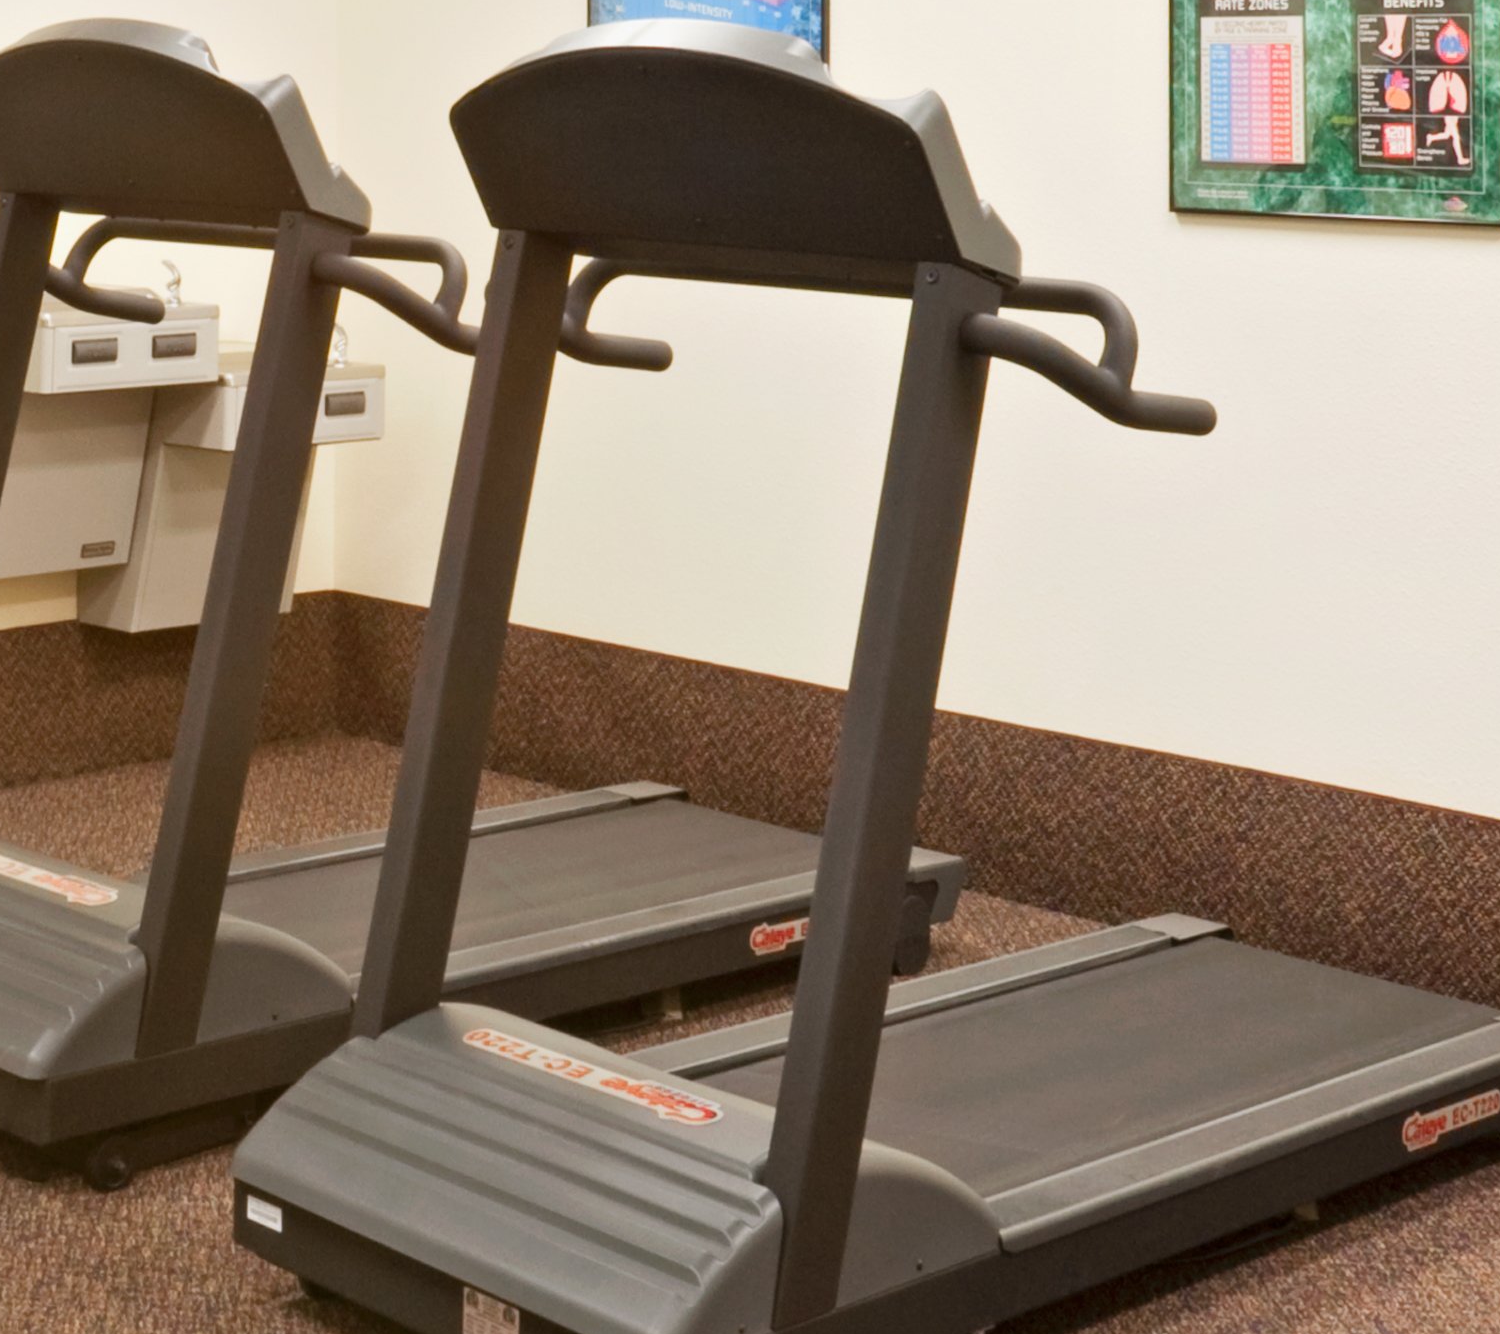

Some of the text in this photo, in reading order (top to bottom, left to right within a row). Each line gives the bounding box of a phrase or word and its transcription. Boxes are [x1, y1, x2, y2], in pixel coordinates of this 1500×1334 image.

[467, 1030, 718, 1123] Cateye EC-T220
[1404, 1093, 1500, 1143] Cateye EC-T220
